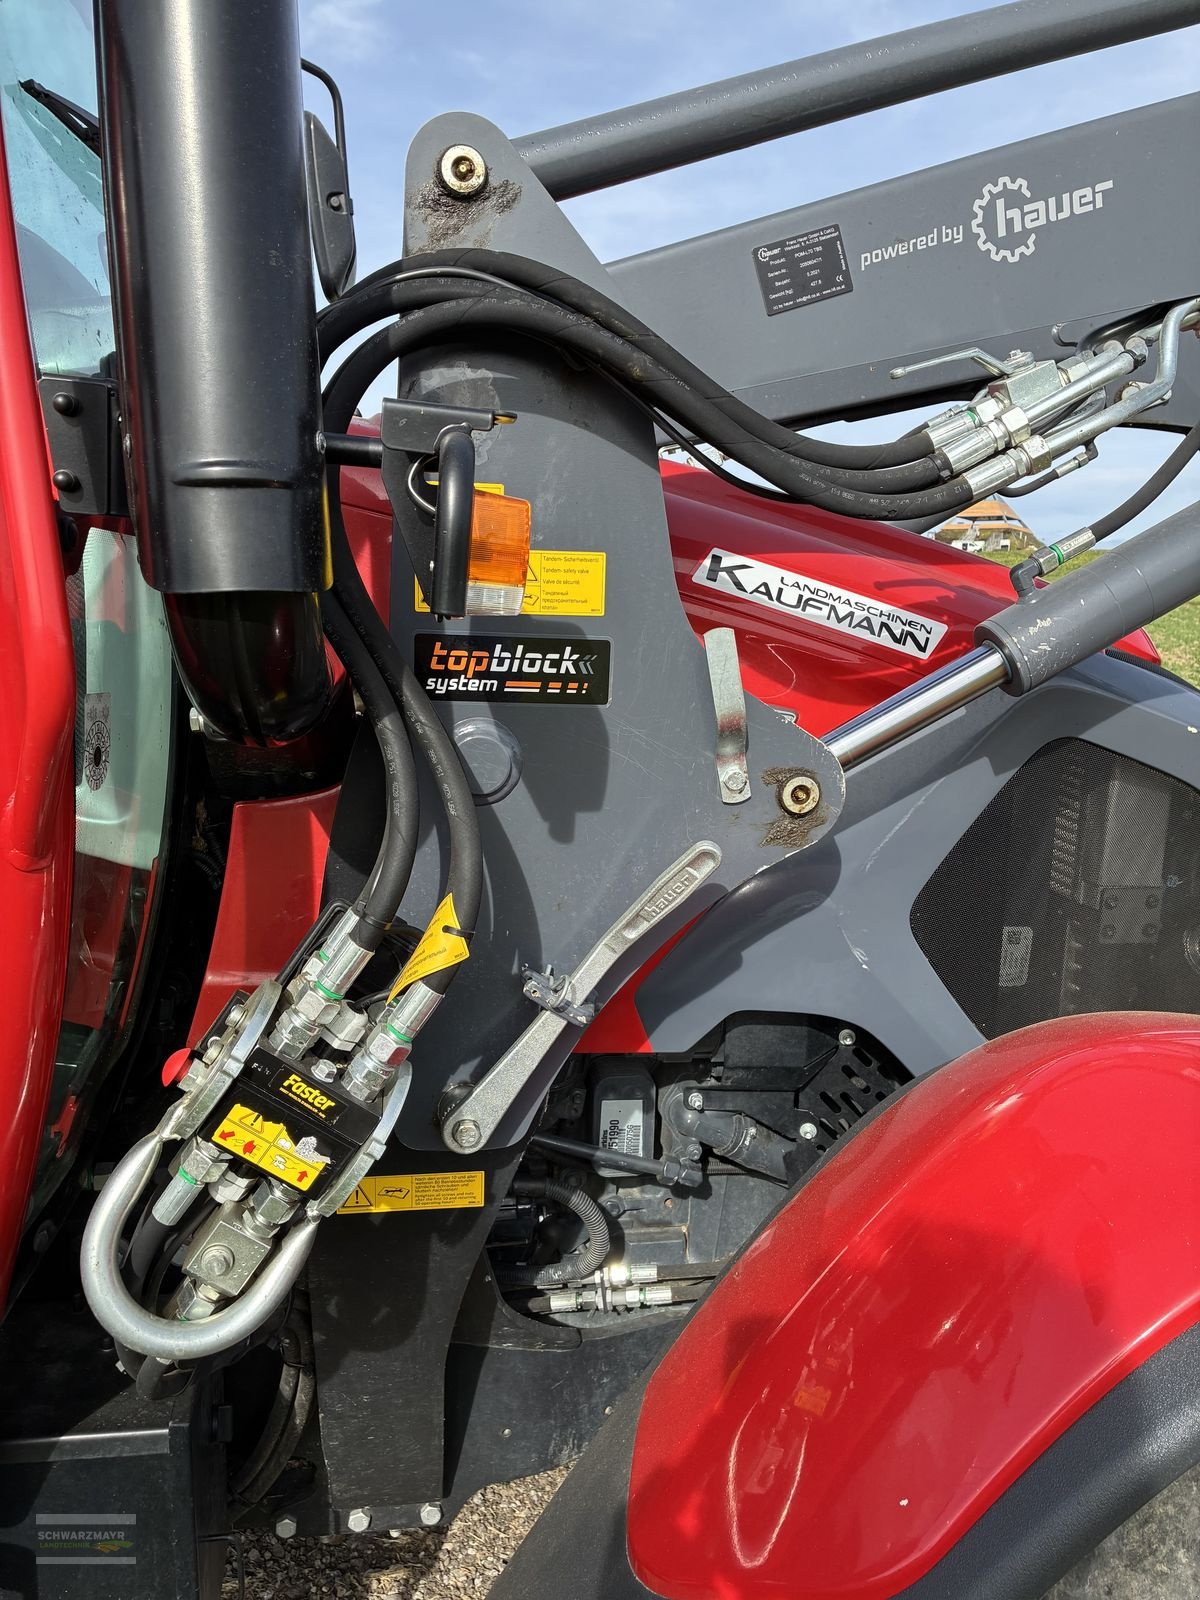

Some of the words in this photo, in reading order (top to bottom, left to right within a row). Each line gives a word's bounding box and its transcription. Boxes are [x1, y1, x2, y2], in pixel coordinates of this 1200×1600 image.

[995, 179, 1114, 238] hauer
[860, 228, 938, 271] powered
[942, 225, 964, 244] by
[705, 554, 930, 654] KAUFMANN
[780, 576, 932, 635] LANDMASCHINEN
[425, 676, 498, 694] system
[645, 874, 690, 916] hauer
[282, 1074, 336, 1110] Faster
